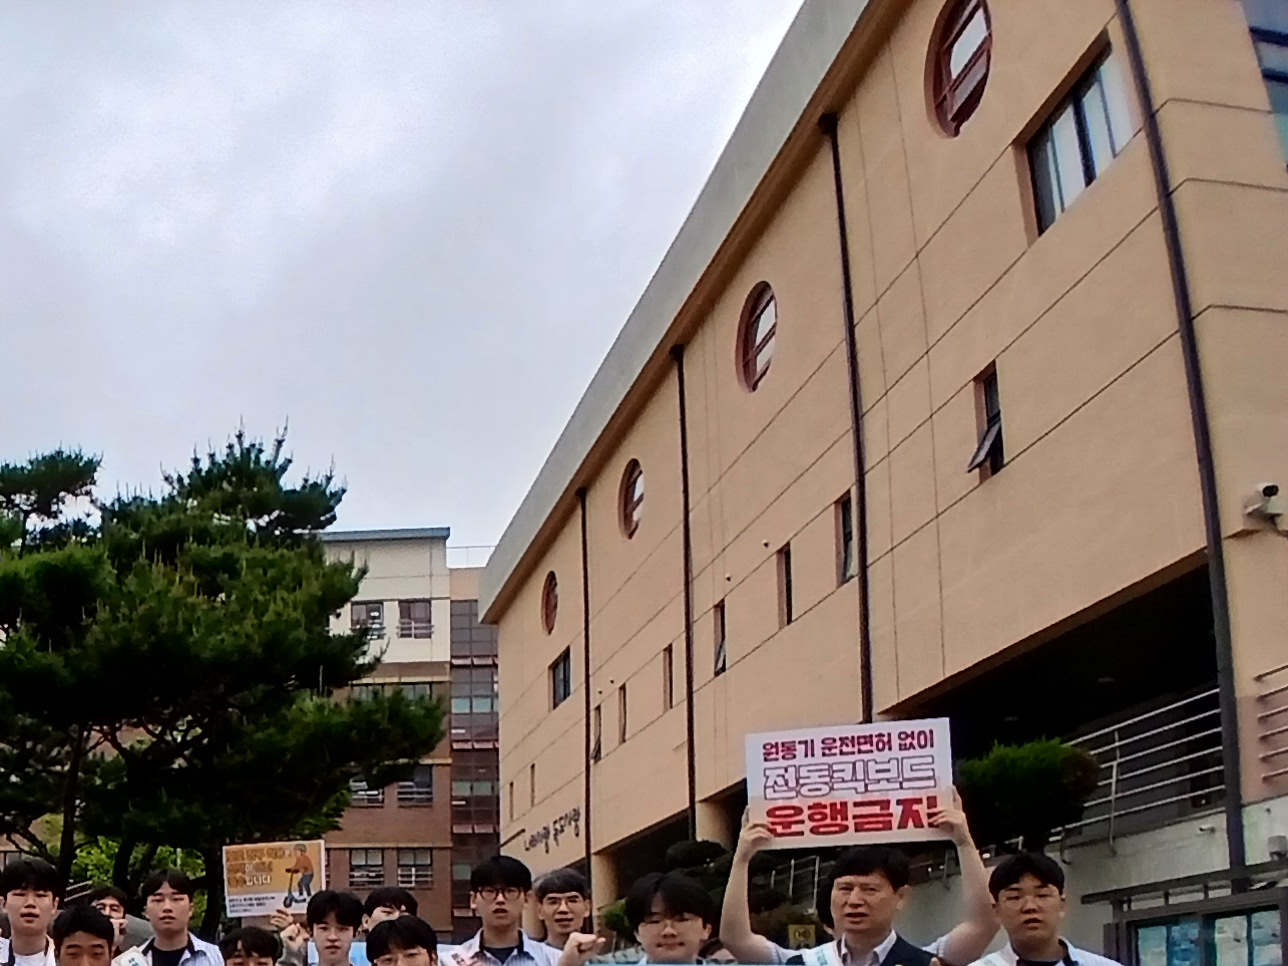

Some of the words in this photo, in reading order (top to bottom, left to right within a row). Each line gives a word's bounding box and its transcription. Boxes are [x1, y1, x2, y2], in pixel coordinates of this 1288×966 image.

[762, 738, 816, 763] 원동기
[820, 731, 893, 758] 운전면허
[897, 728, 935, 752] 없이
[763, 754, 938, 801] 전동킥보드
[765, 795, 941, 838] 운행금지
